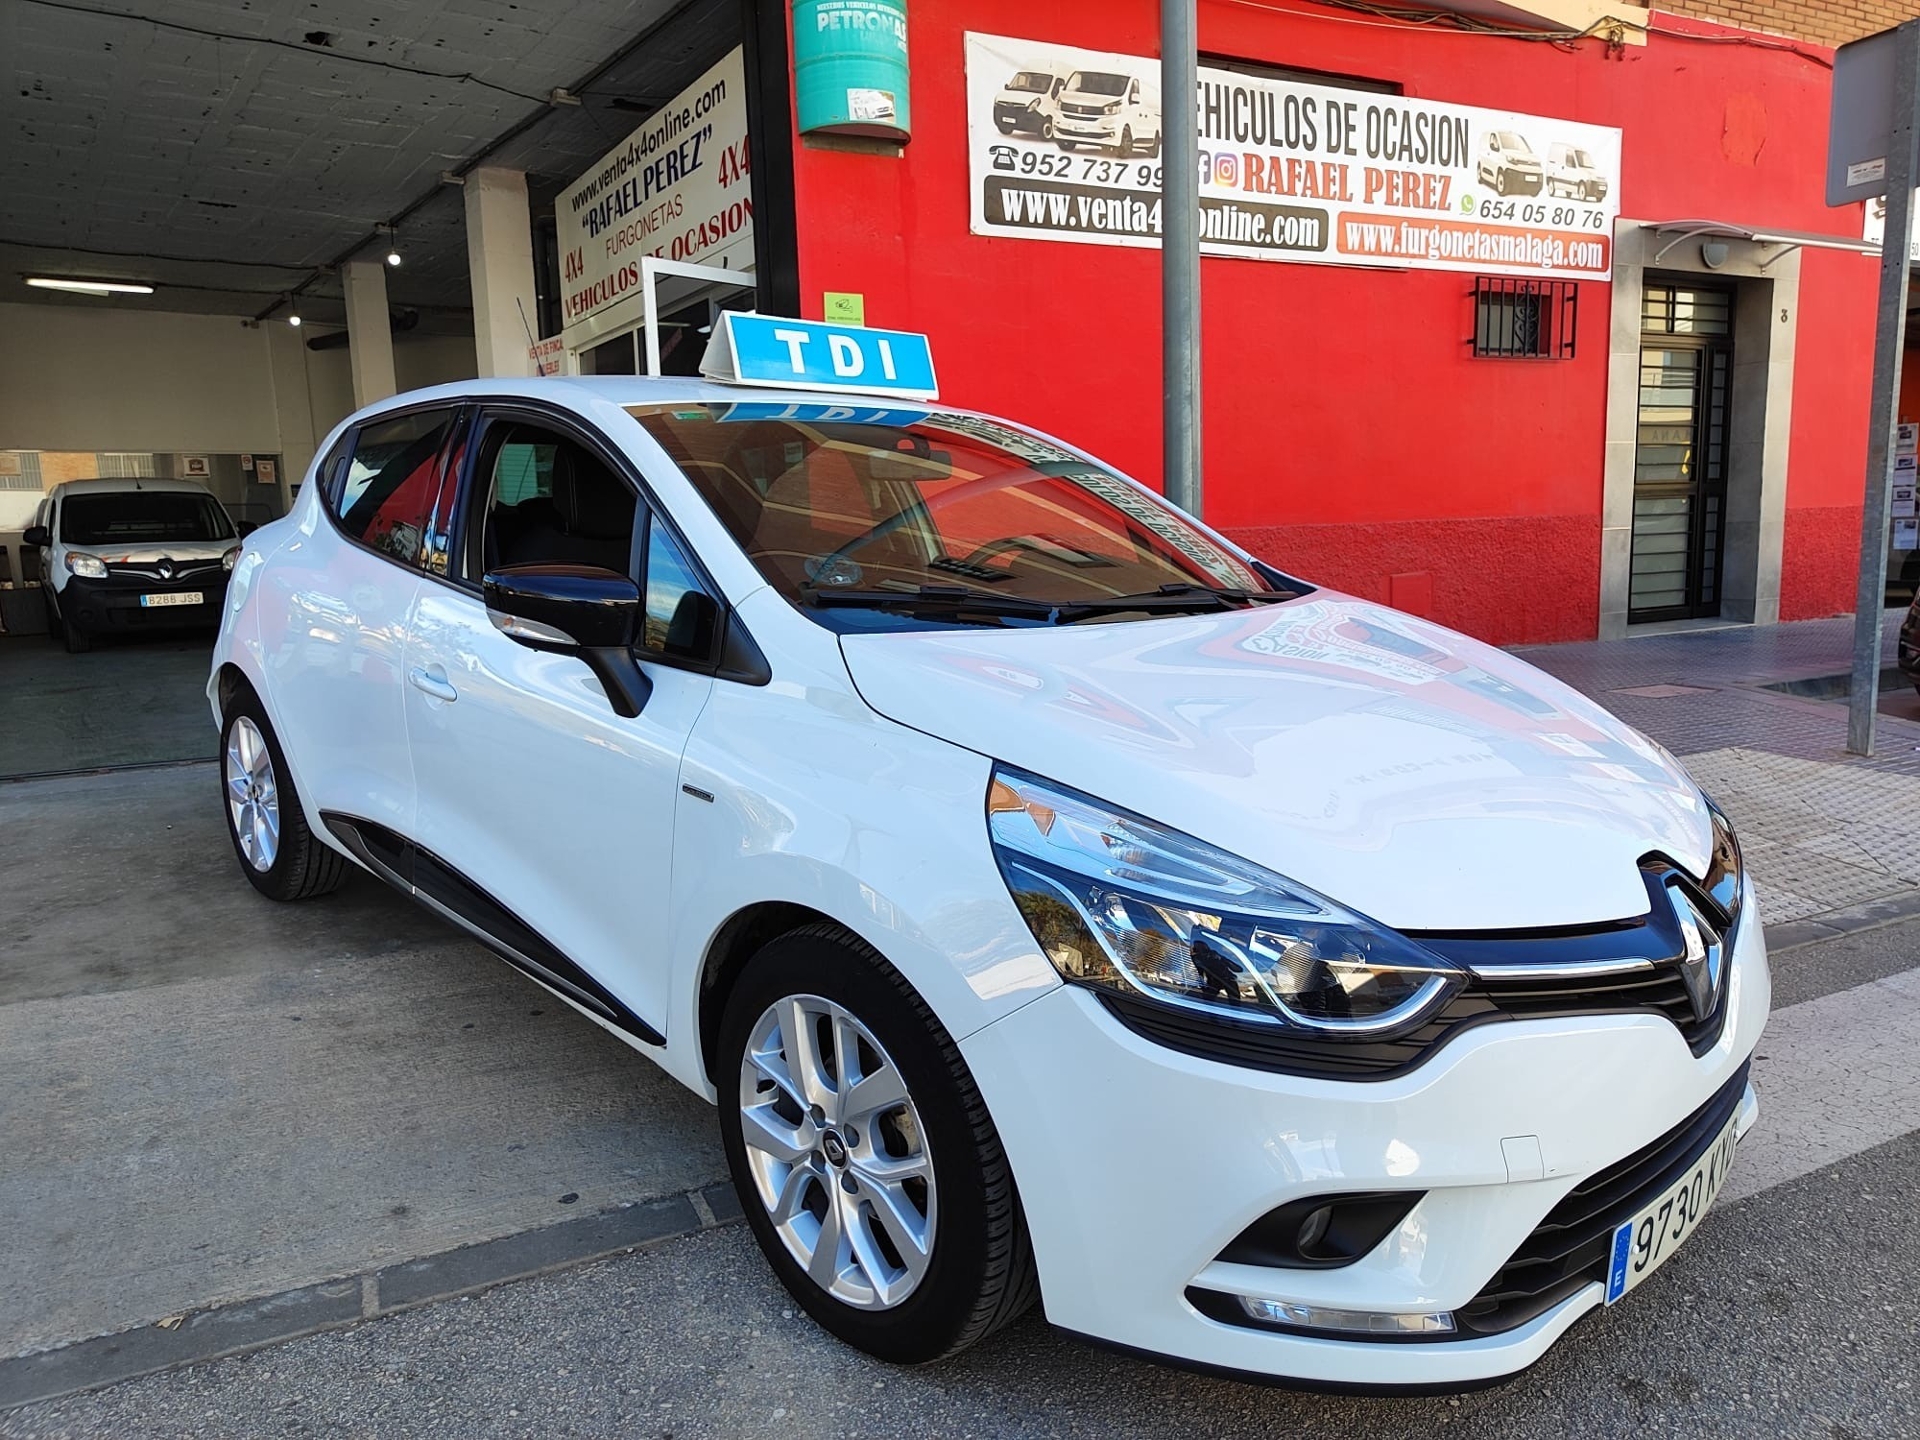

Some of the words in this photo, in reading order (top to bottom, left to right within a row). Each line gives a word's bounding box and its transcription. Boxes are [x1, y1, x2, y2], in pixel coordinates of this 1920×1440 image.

[817, 9, 907, 42] PETRONAS
[571, 78, 727, 213] www.venta4x4online.com
[717, 133, 750, 190] 4X4
[1326, 99, 1358, 157] DE
[1366, 104, 1469, 169] OCASION
[1020, 150, 1072, 178] 952
[1081, 157, 1130, 185] 737
[1136, 163, 1163, 189] 99
[1242, 153, 1353, 203] RAFAEL
[1363, 165, 1452, 211] PEREZ
[606, 193, 684, 259] FURGONETAS
[1479, 199, 1516, 222] 654
[1522, 203, 1546, 224] 05
[1551, 206, 1576, 227] 80
[1582, 210, 1605, 230] 76
[564, 245, 585, 283] 4X4
[1344, 220, 1604, 269] www.furgonetasmalaga.com
[564, 261, 640, 320] VEHICULOS
[774, 327, 898, 381] TDI
[1633, 1169, 1704, 1273] 9730
